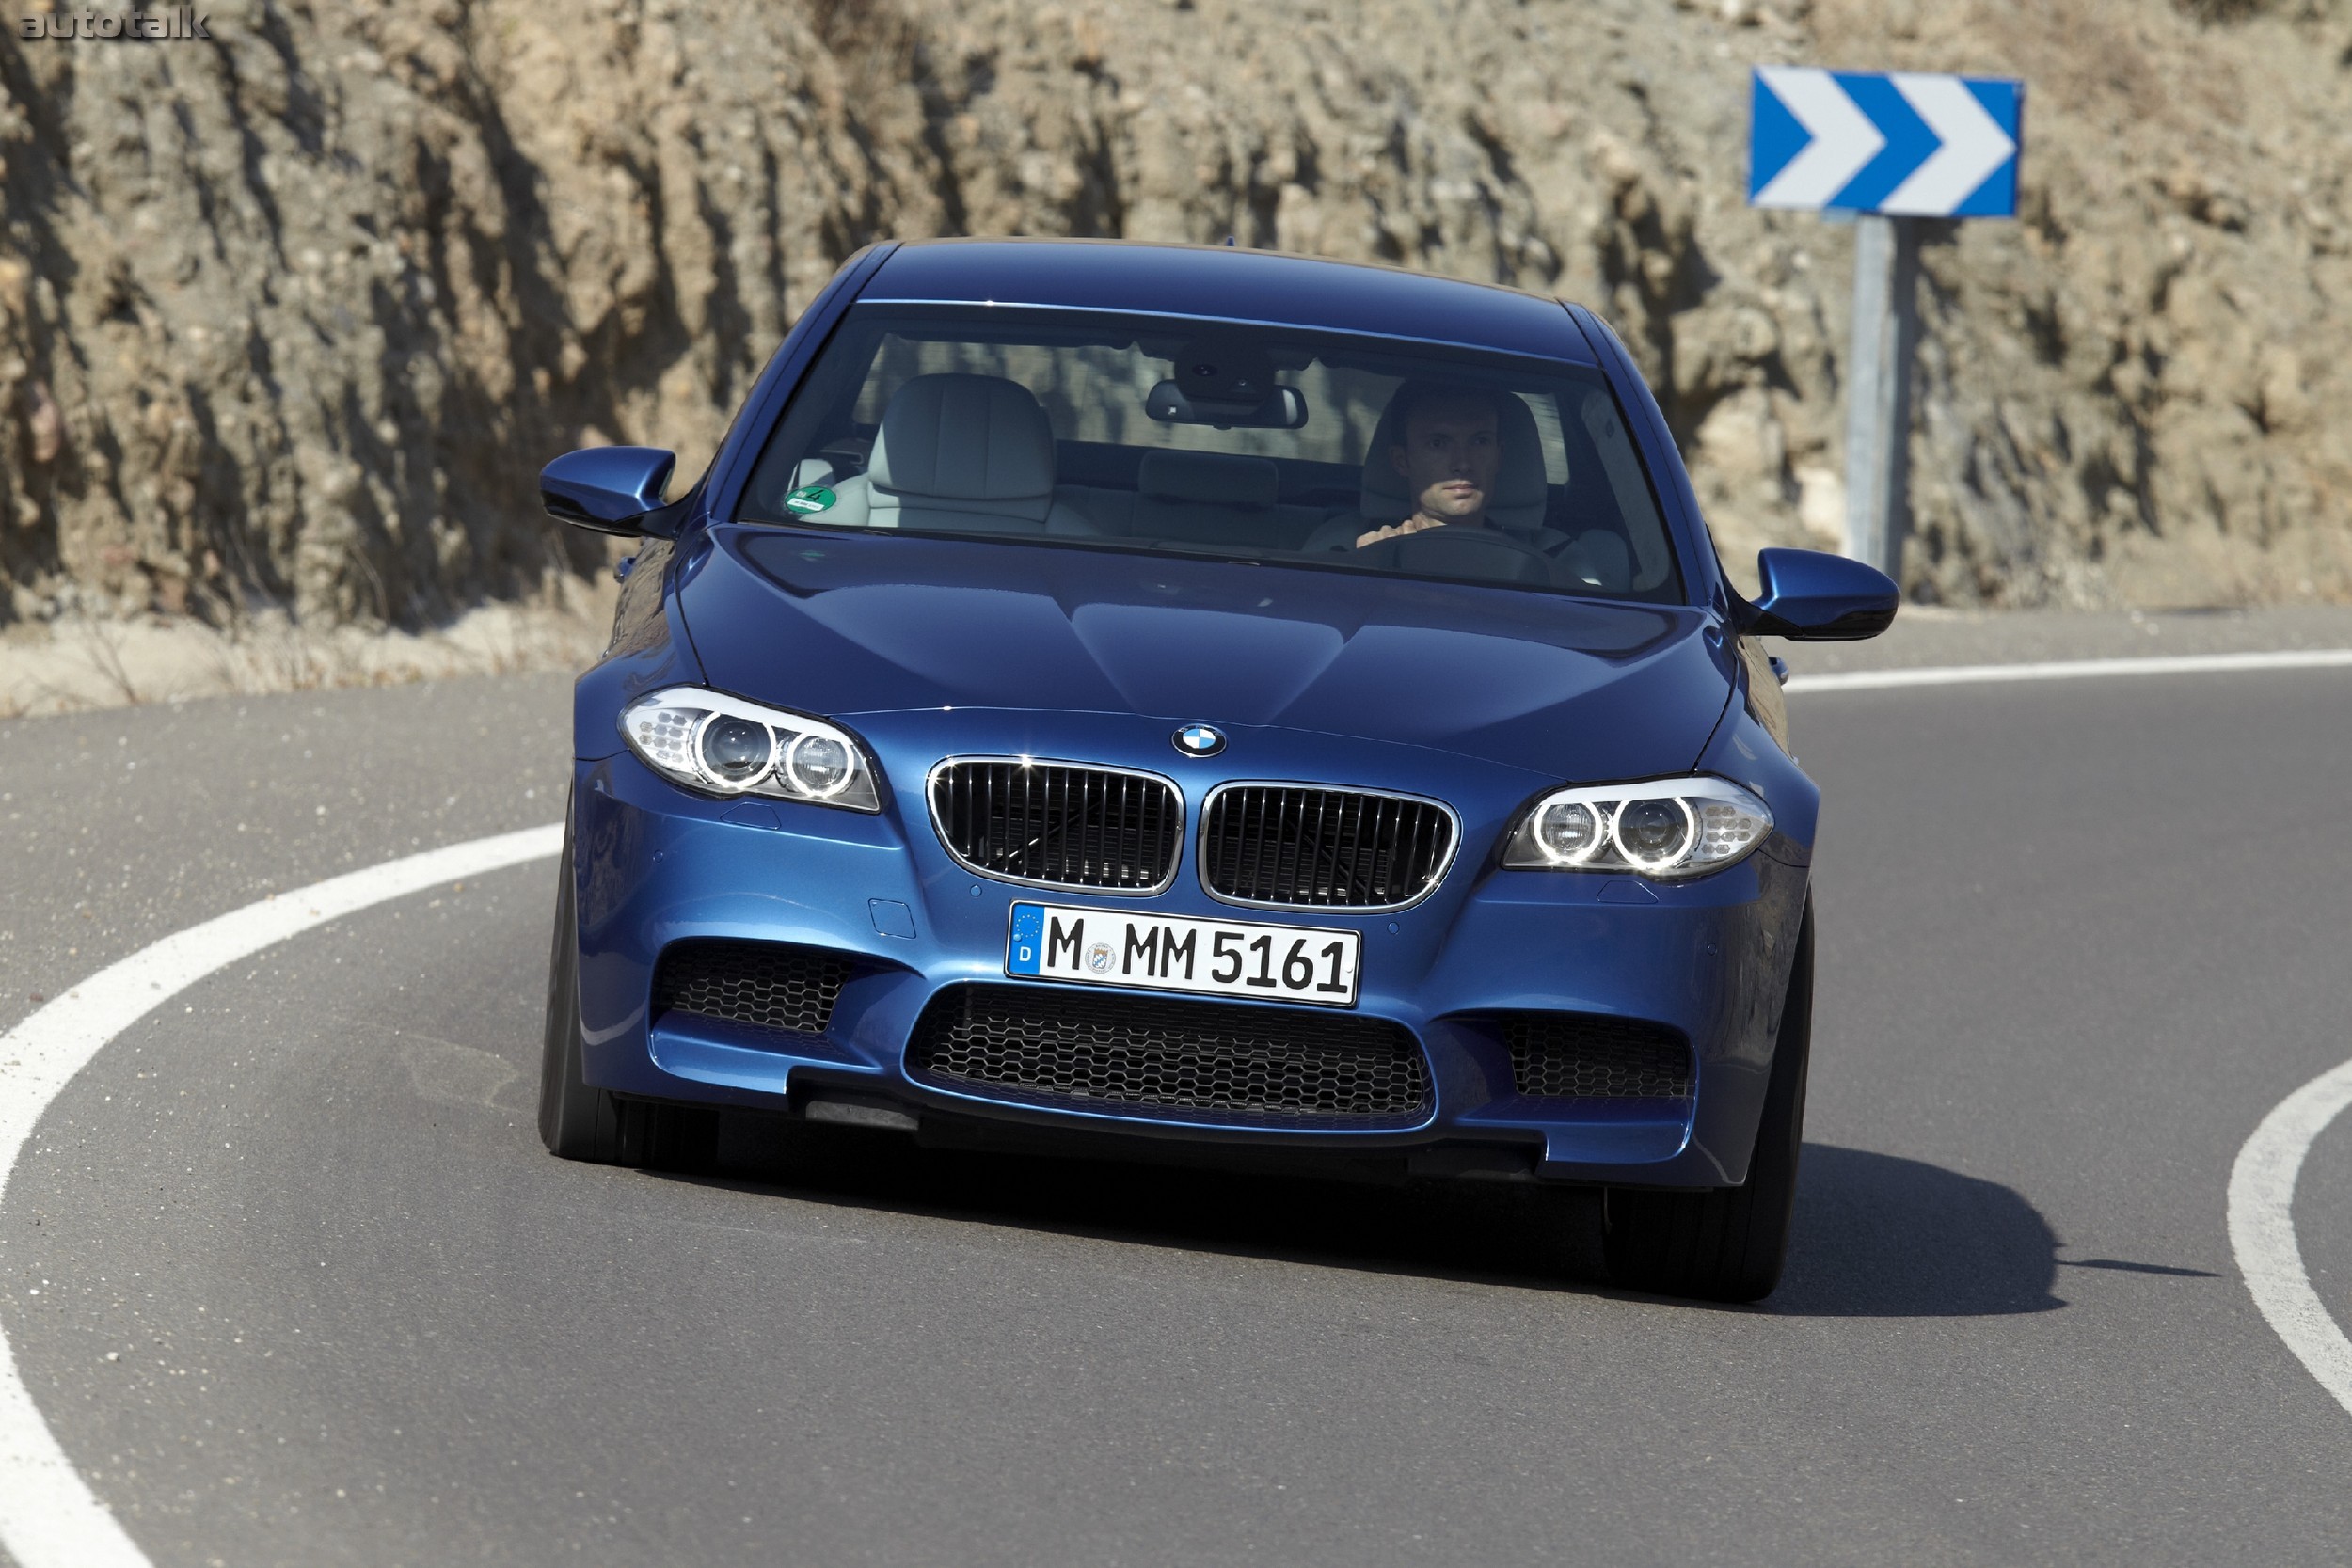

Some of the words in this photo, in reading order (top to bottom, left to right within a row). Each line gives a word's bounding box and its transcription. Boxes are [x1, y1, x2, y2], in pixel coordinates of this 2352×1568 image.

[806, 489, 824, 502] 4
[1019, 946, 1031, 961] D
[1047, 916, 1084, 970] M
[1122, 922, 1197, 980] MM
[1211, 930, 1349, 994] 5161
